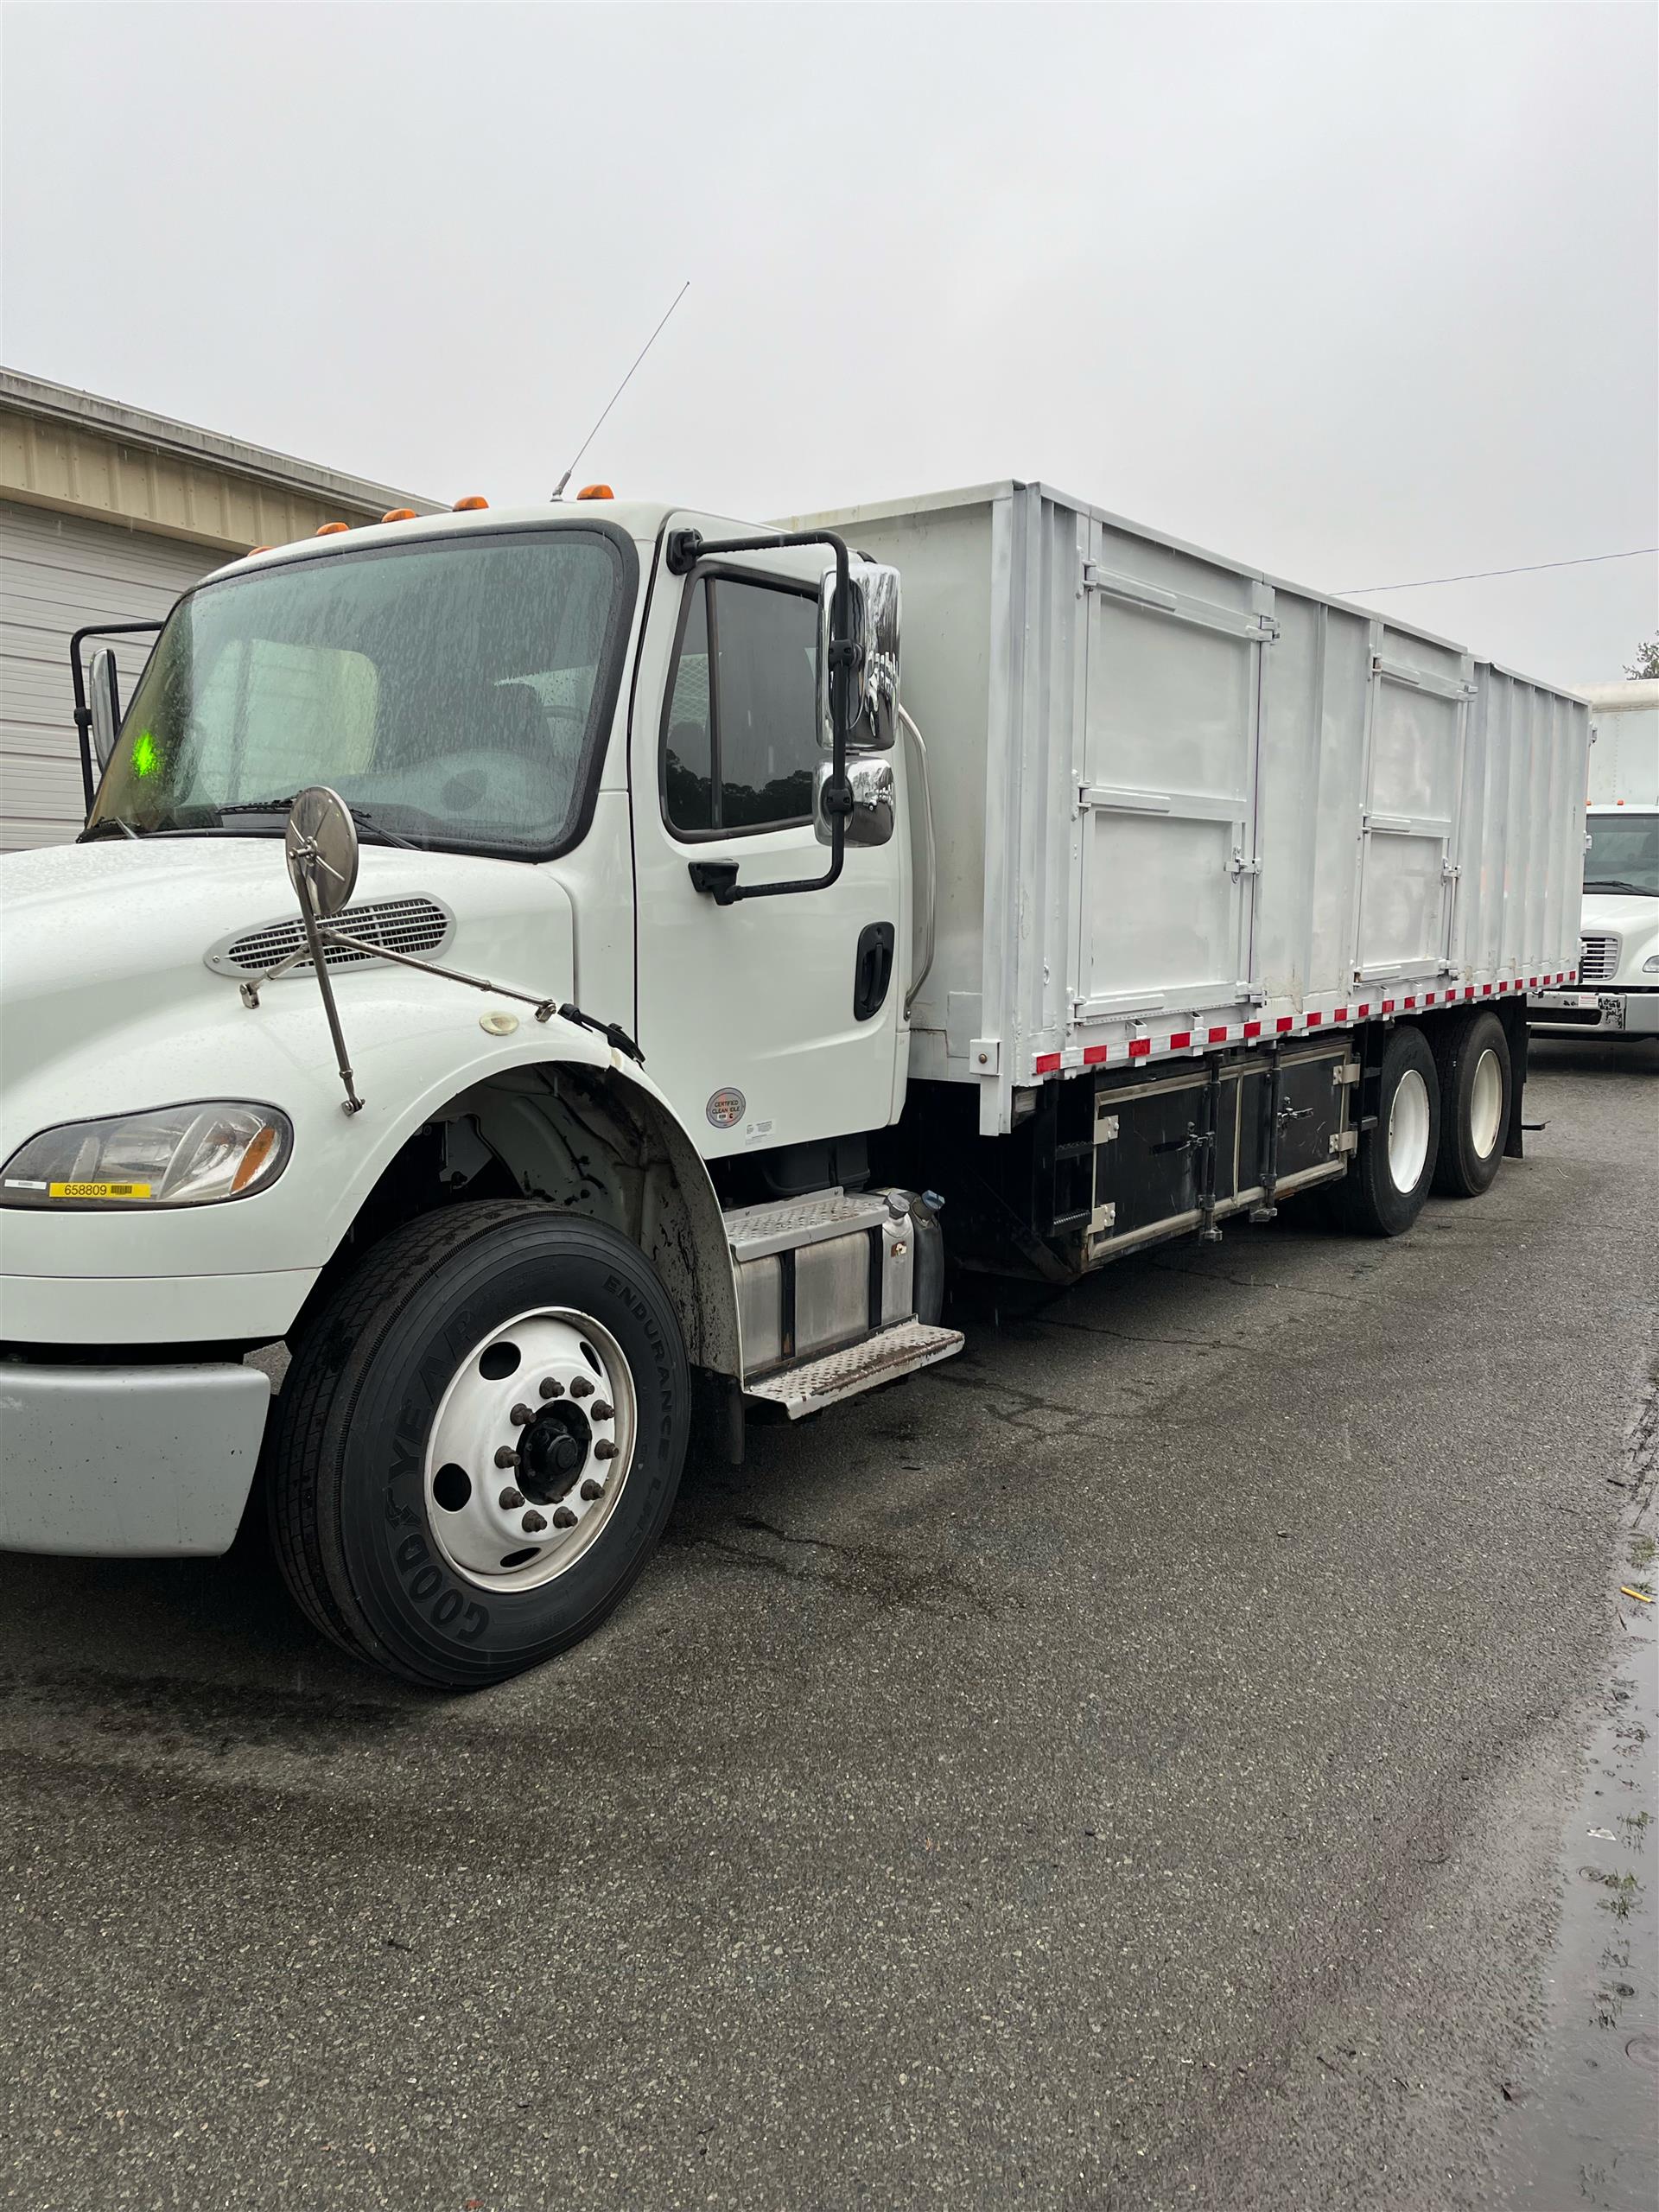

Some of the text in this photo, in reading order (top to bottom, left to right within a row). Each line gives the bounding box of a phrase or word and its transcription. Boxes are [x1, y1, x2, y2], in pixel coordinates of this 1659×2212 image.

[64, 1185, 107, 1196] 658809
[601, 1274, 672, 1461] ENDURANCE
[385, 1311, 490, 1642] GOODYEAR
